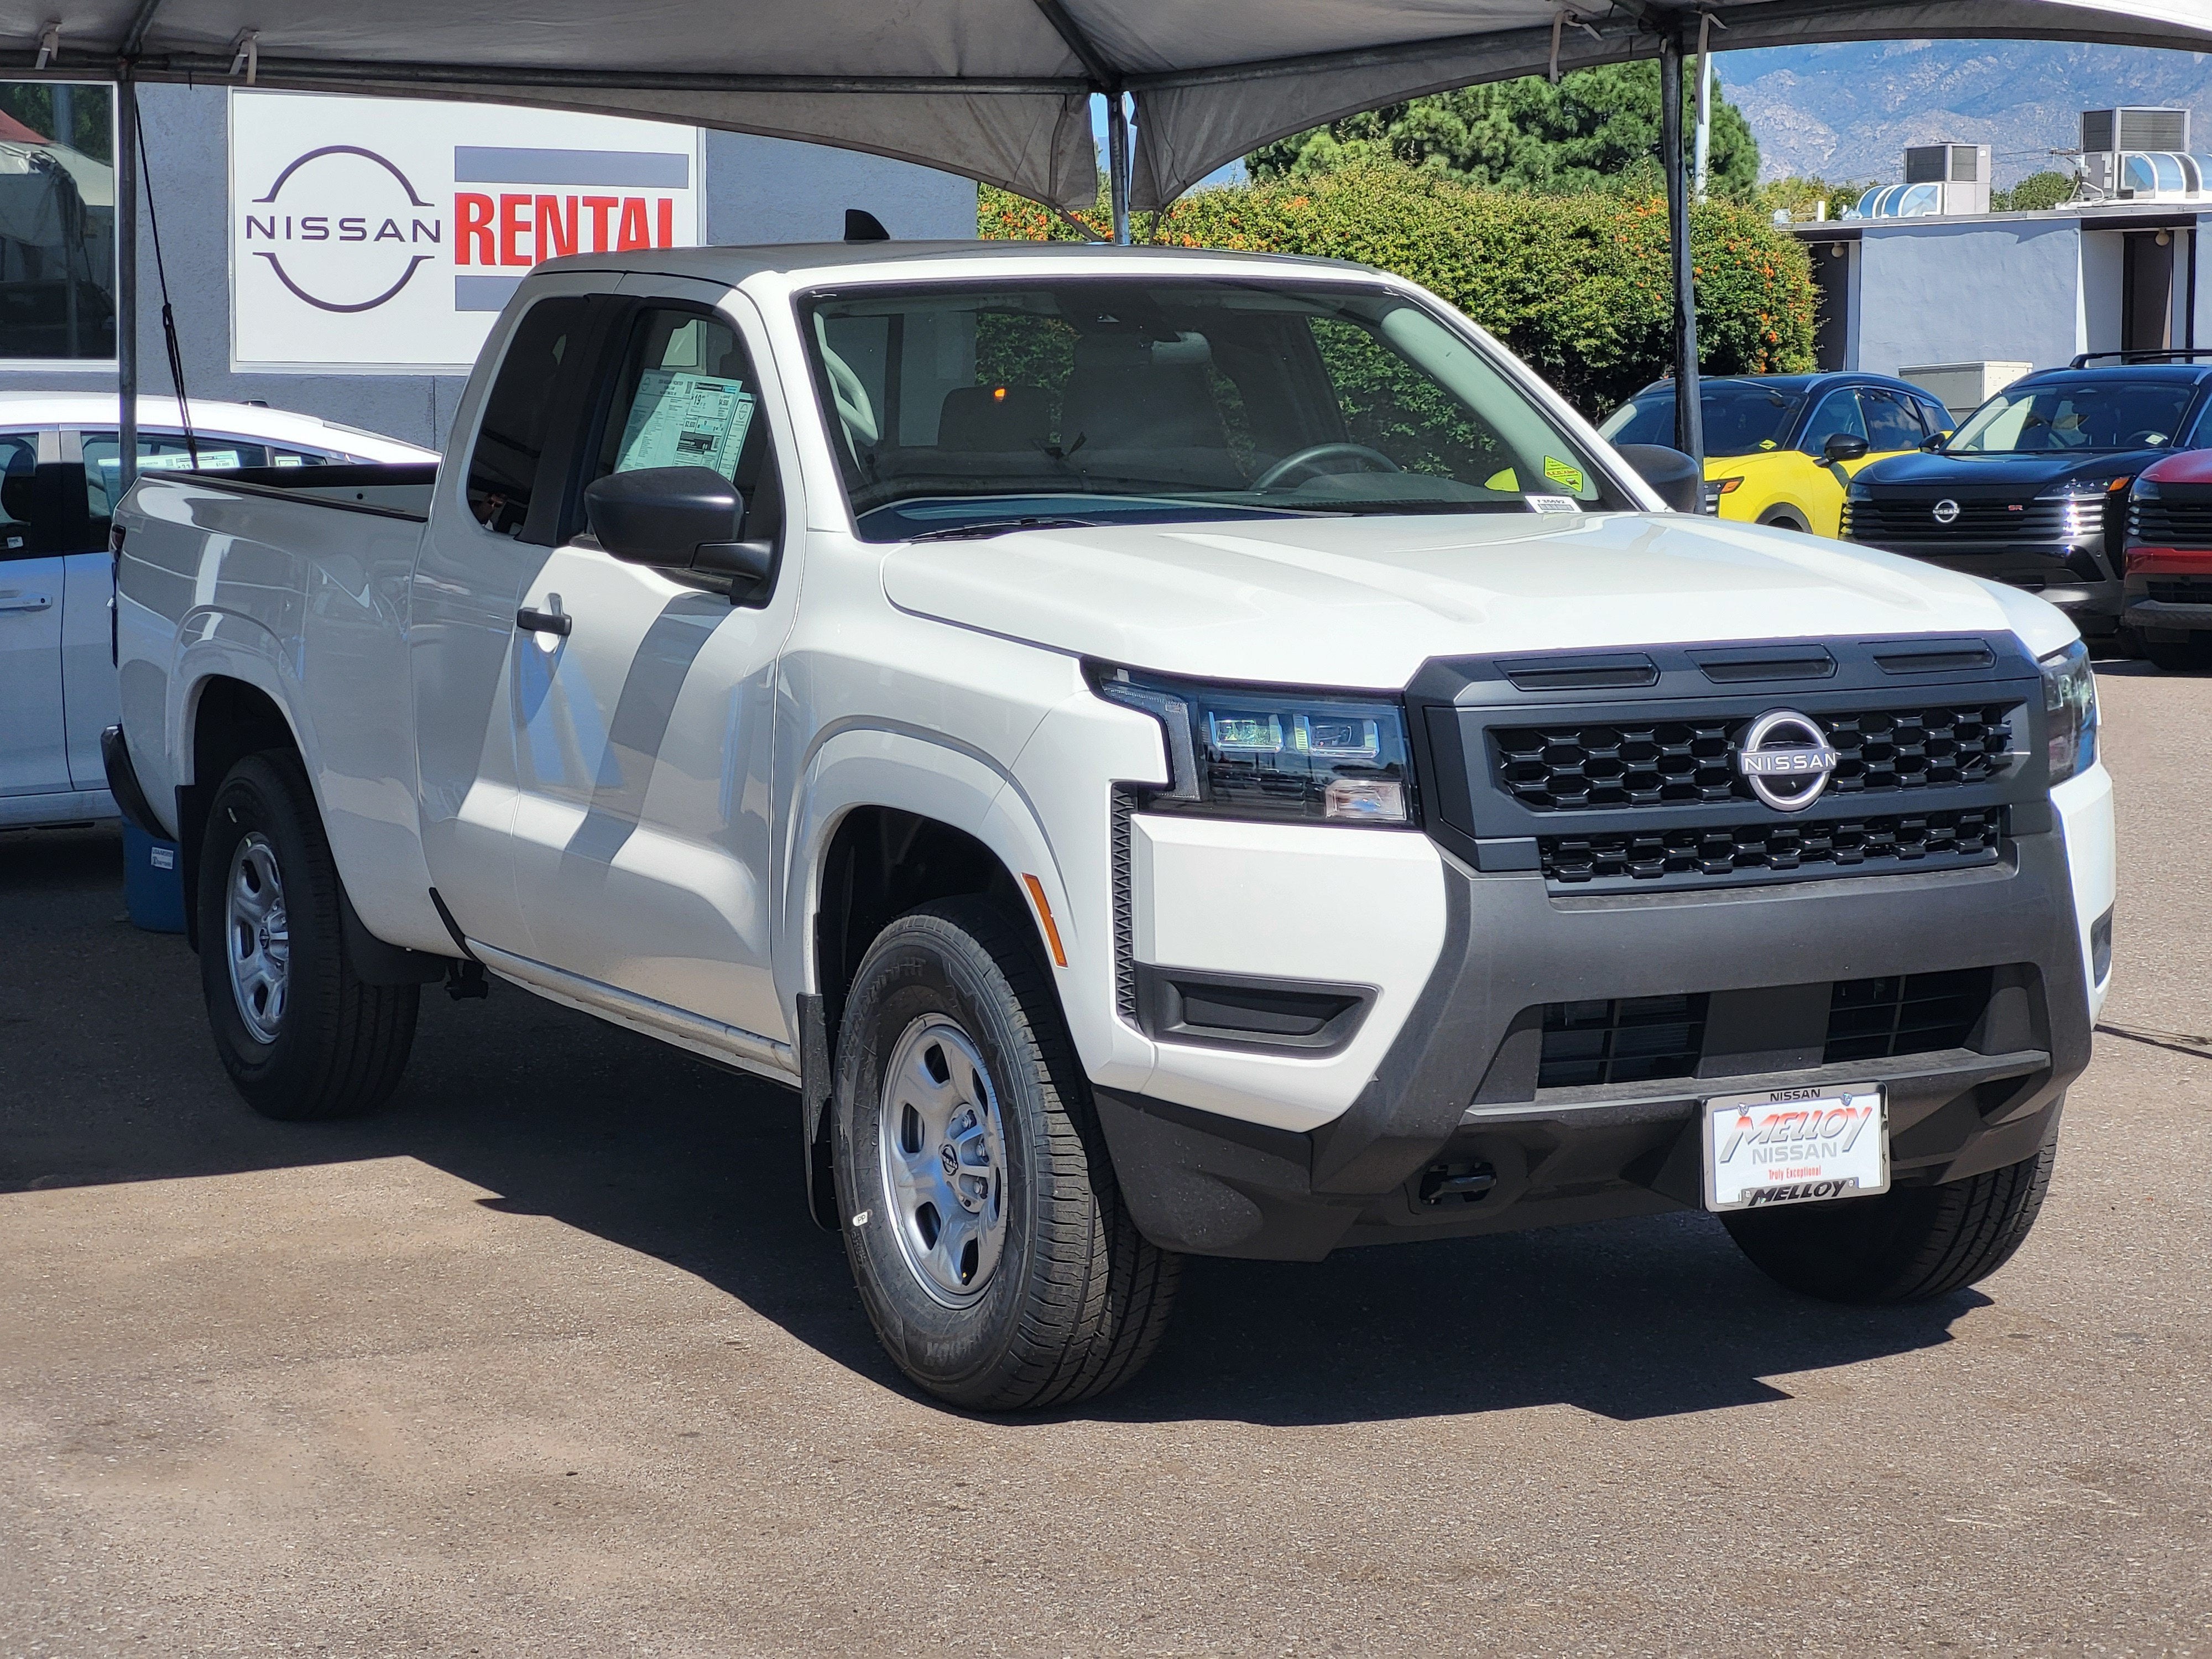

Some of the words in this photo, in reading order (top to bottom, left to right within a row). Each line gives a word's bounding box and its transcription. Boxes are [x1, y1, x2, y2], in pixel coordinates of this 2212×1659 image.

[246, 215, 441, 243] NISSAN
[455, 192, 673, 266] RENTAL
[1744, 753, 1837, 771] NISSAN
[1770, 1088, 1821, 1102] NISSAN
[1719, 1106, 1872, 1164] MELLOY
[1752, 1142, 1837, 1165] NISSAN
[1768, 1168, 1785, 1181] Truly
[1786, 1165, 1822, 1180] Exceptional
[1747, 1180, 1847, 1206] MELLOY
